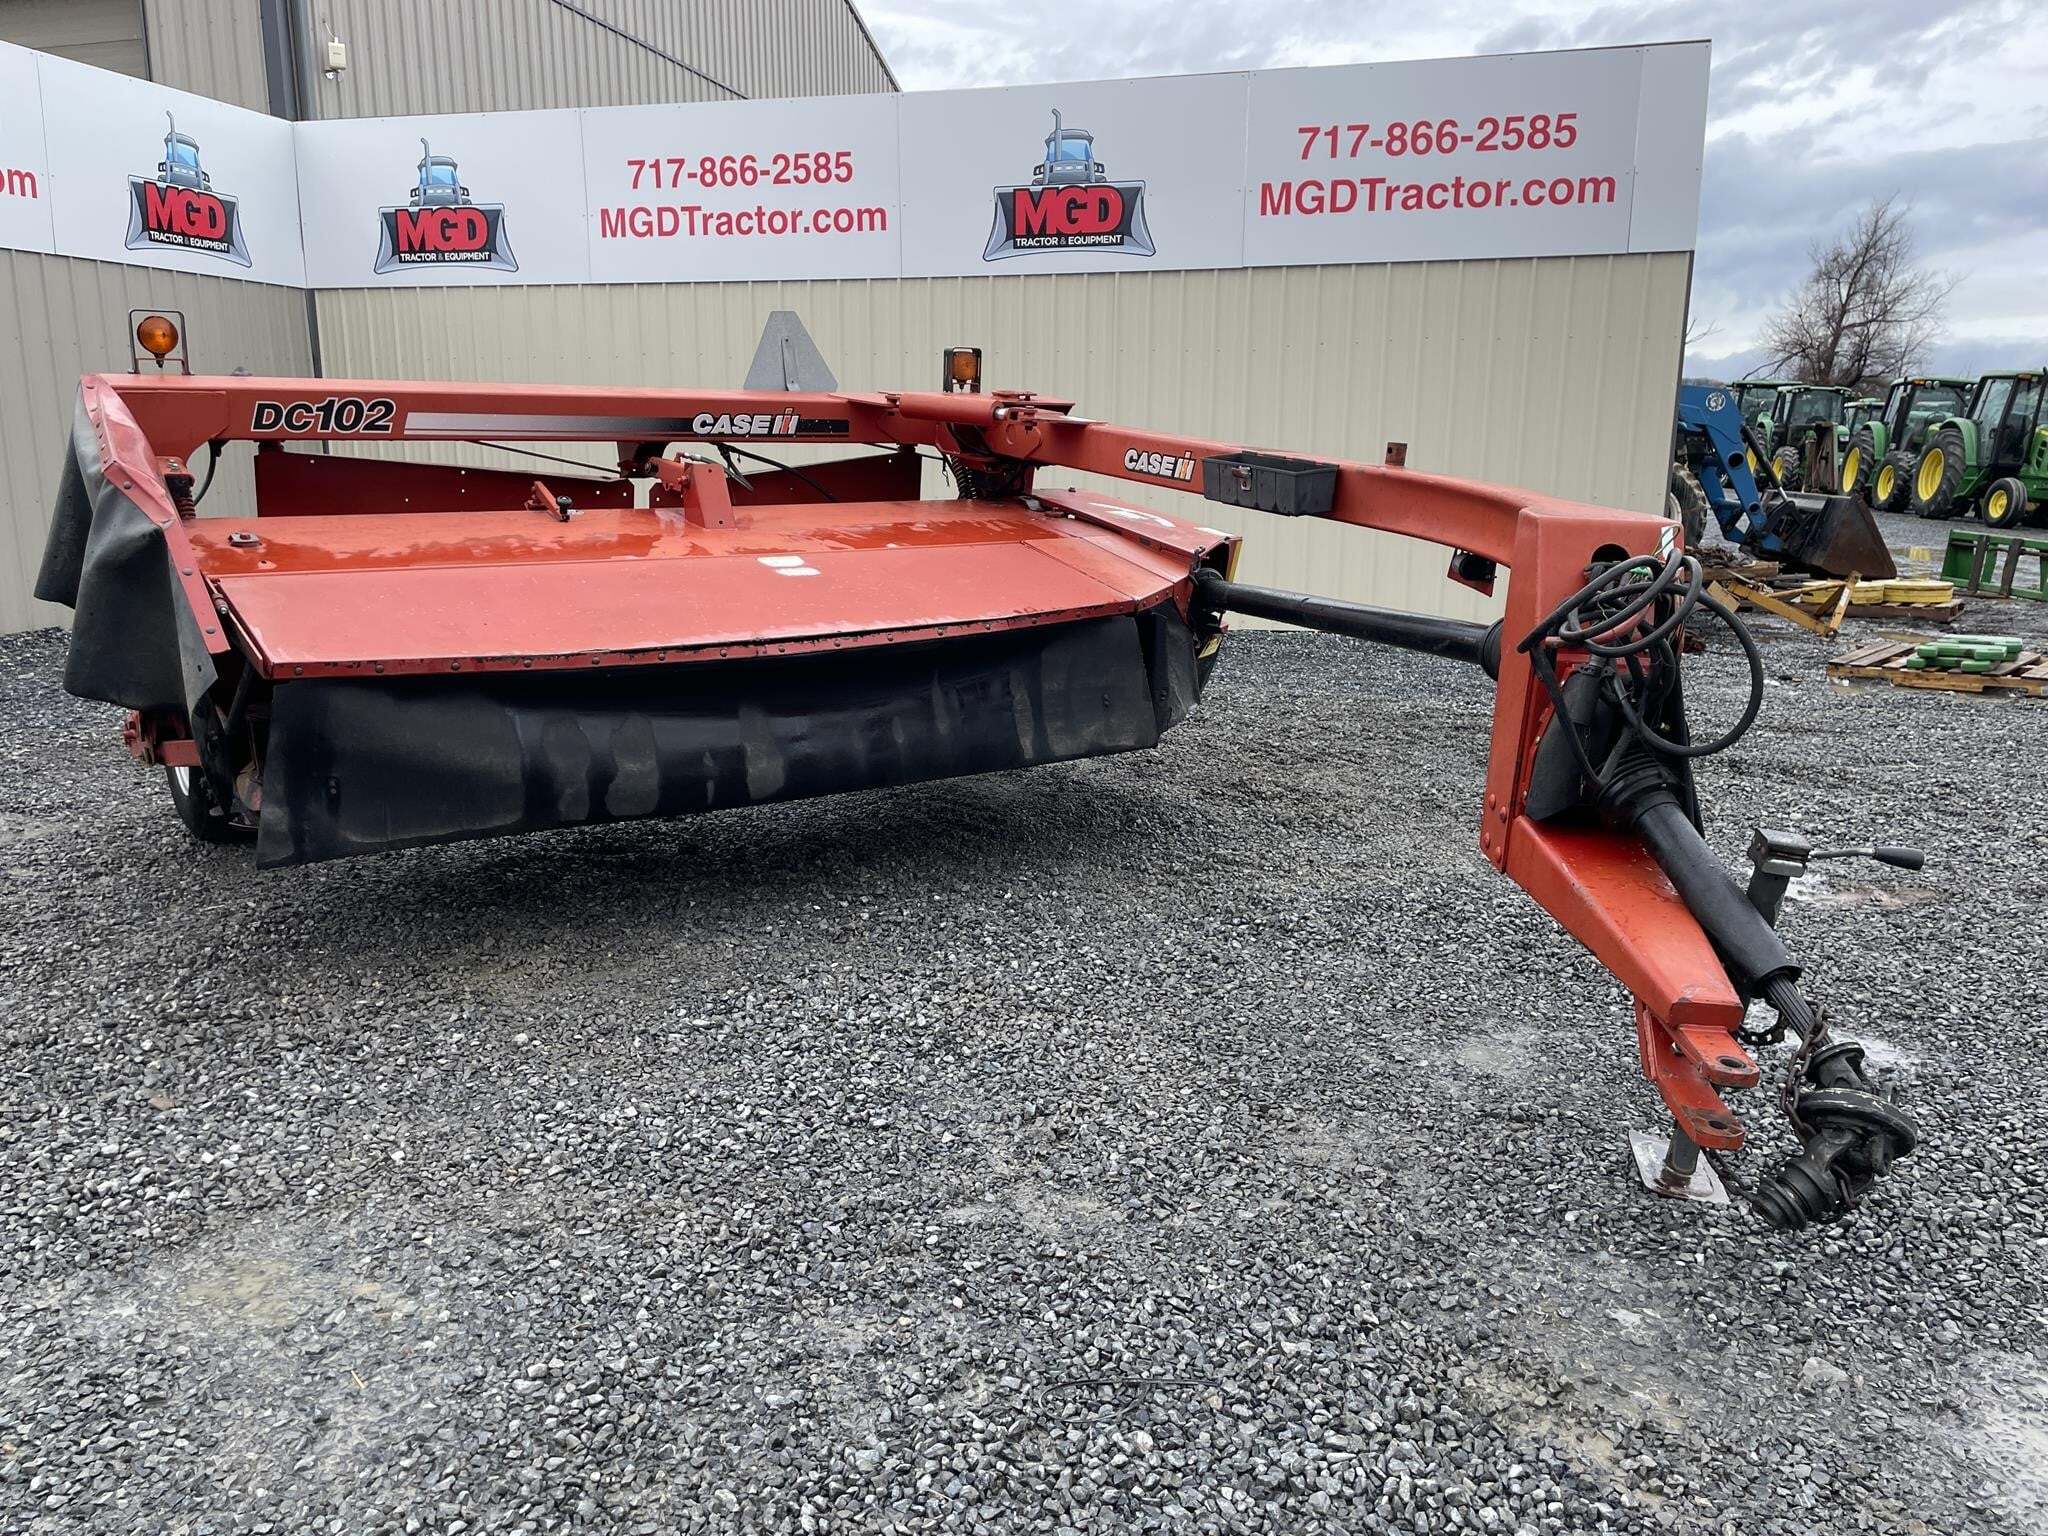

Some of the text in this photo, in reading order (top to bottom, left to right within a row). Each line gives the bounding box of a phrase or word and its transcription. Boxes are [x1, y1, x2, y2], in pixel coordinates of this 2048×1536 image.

[1298, 113, 1577, 160] 717-866-2585
[627, 151, 853, 189] 717-866-2585
[144, 180, 227, 239] MGD
[1013, 185, 1125, 235] MGD
[1260, 175, 1616, 216] MGDTractor.com
[395, 207, 489, 251] MGD
[600, 205, 887, 238] MGDTractor.com
[150, 231, 184, 245] TRACTOR
[190, 238, 229, 251] EQUIPMENT
[400, 253, 437, 262] TRACTOR
[445, 252, 490, 262] EQUIPMENT
[1015, 237, 1059, 247] TRACTOR
[1068, 235, 1122, 245] EQUIPMENT
[251, 397, 396, 434] DC102
[692, 412, 771, 435] CASE
[1124, 449, 1175, 477] CASE
